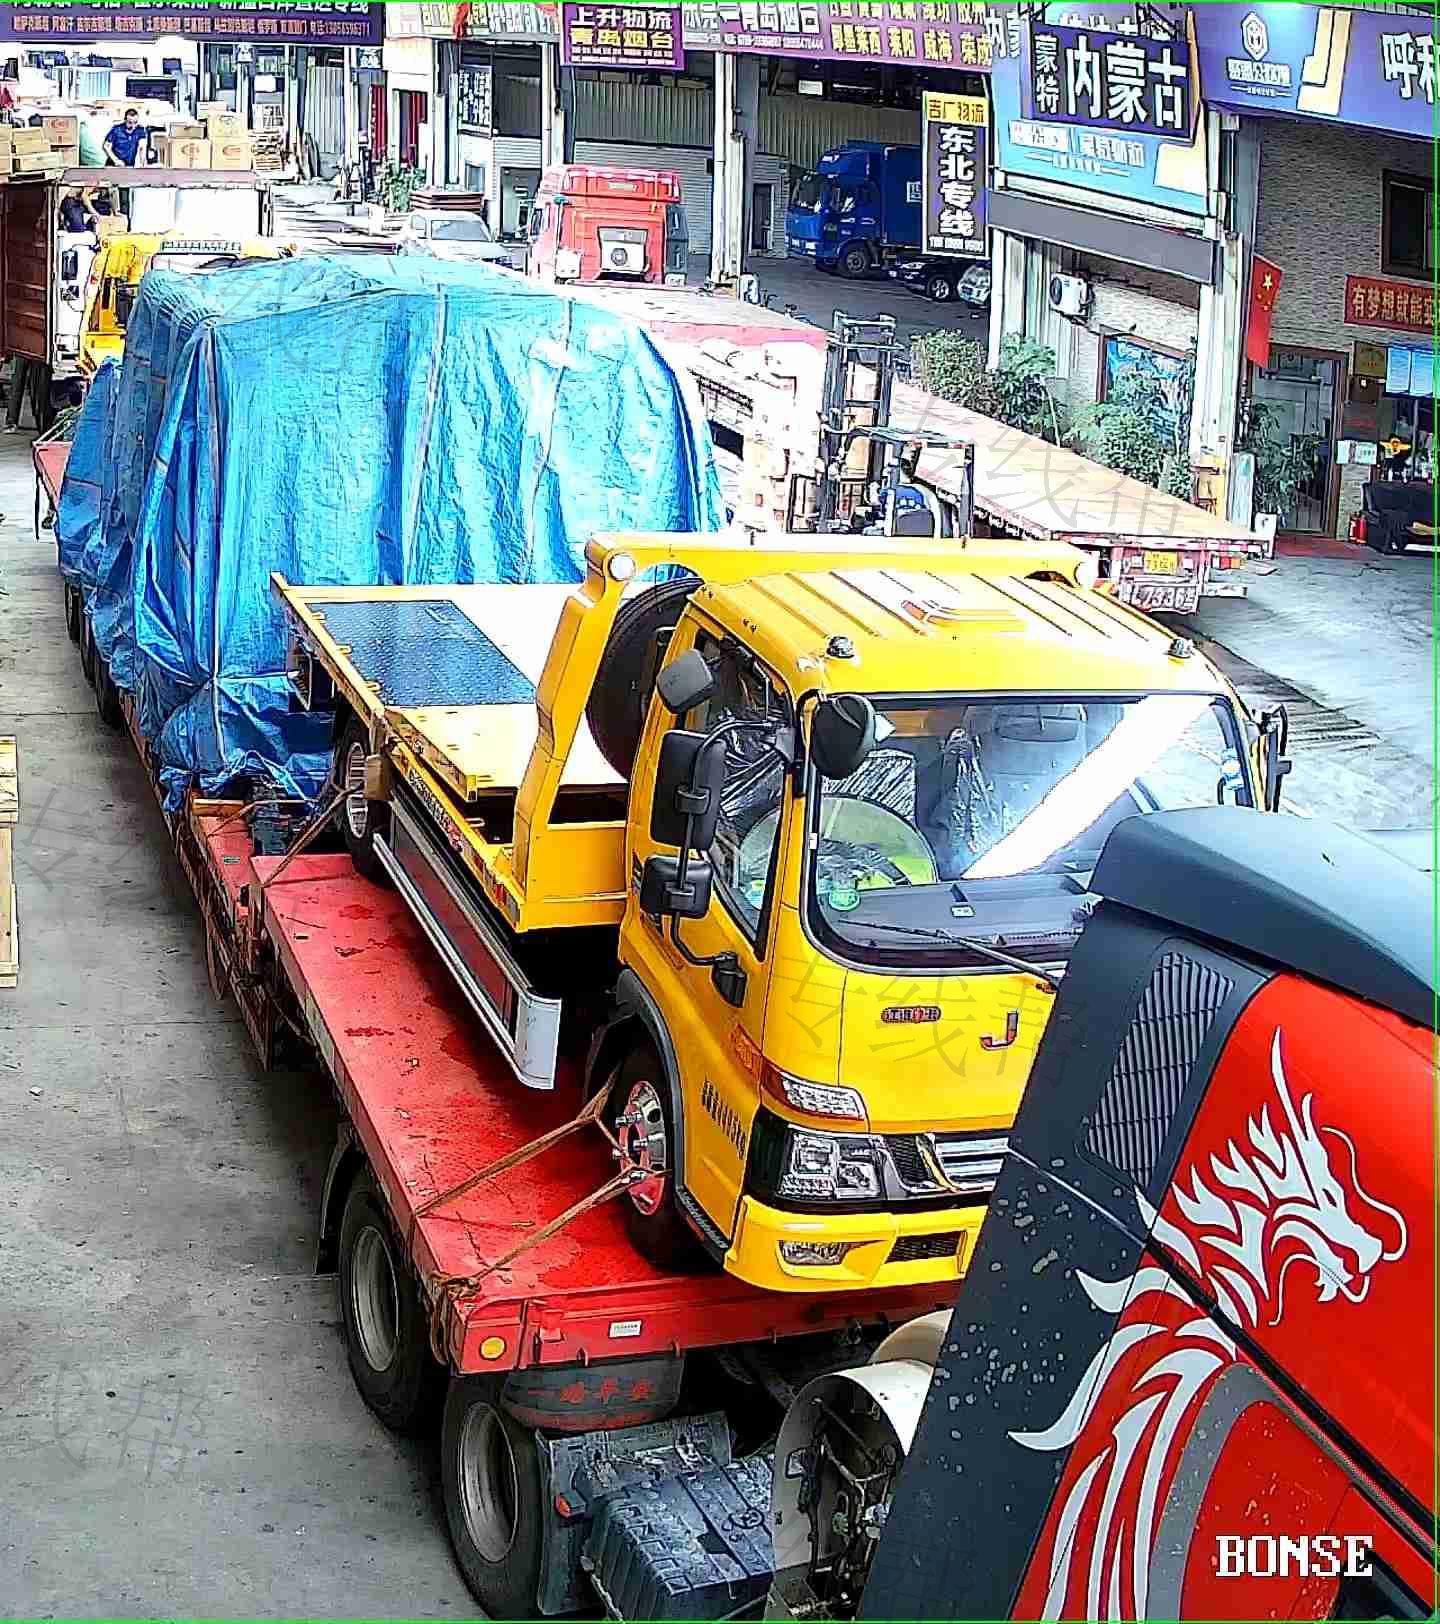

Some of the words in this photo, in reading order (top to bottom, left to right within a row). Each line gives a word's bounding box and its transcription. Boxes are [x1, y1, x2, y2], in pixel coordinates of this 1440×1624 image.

[571, 27, 674, 49] 青岛烟台
[572, 6, 674, 30] 上升物流
[1064, 34, 1188, 129] 内蒙古
[938, 125, 976, 236] 东北专线
